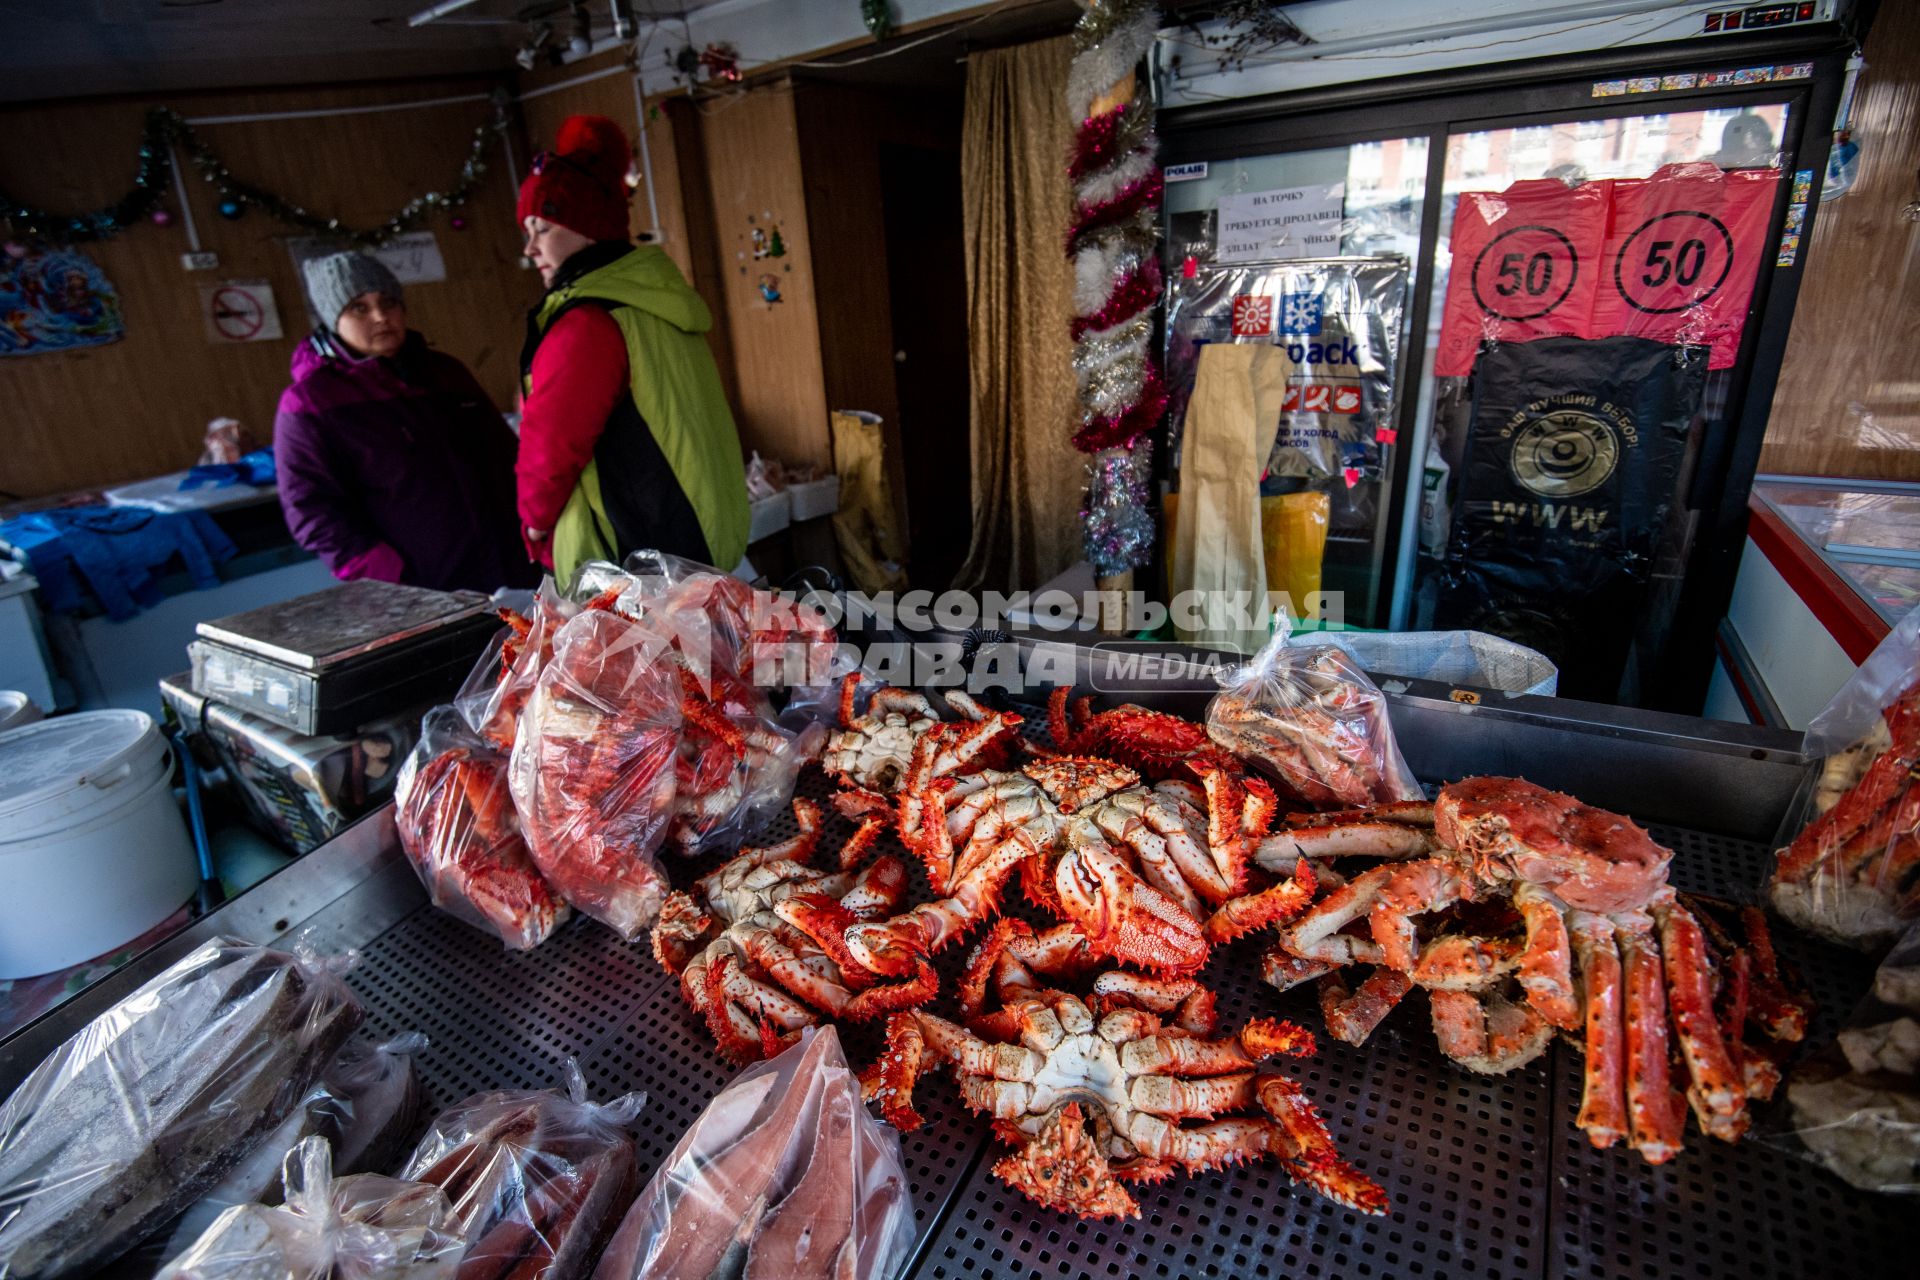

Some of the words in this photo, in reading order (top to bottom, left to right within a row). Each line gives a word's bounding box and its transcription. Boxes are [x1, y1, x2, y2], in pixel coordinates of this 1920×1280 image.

[1166, 164, 1204, 176] POLAIR
[1253, 196, 1268, 205] НА
[1271, 191, 1305, 203] ТОЧКУ
[1224, 217, 1281, 232] ТРЕБУЕТСЯ
[1283, 210, 1340, 225] ПРОДАВЕЦ
[1496, 251, 1553, 296] 50
[1642, 239, 1706, 288] 50
[1501, 411, 1526, 438] ВАШ
[1530, 394, 1597, 412] ЛУЧШИЙ
[1601, 402, 1639, 448] ВЫБОР!
